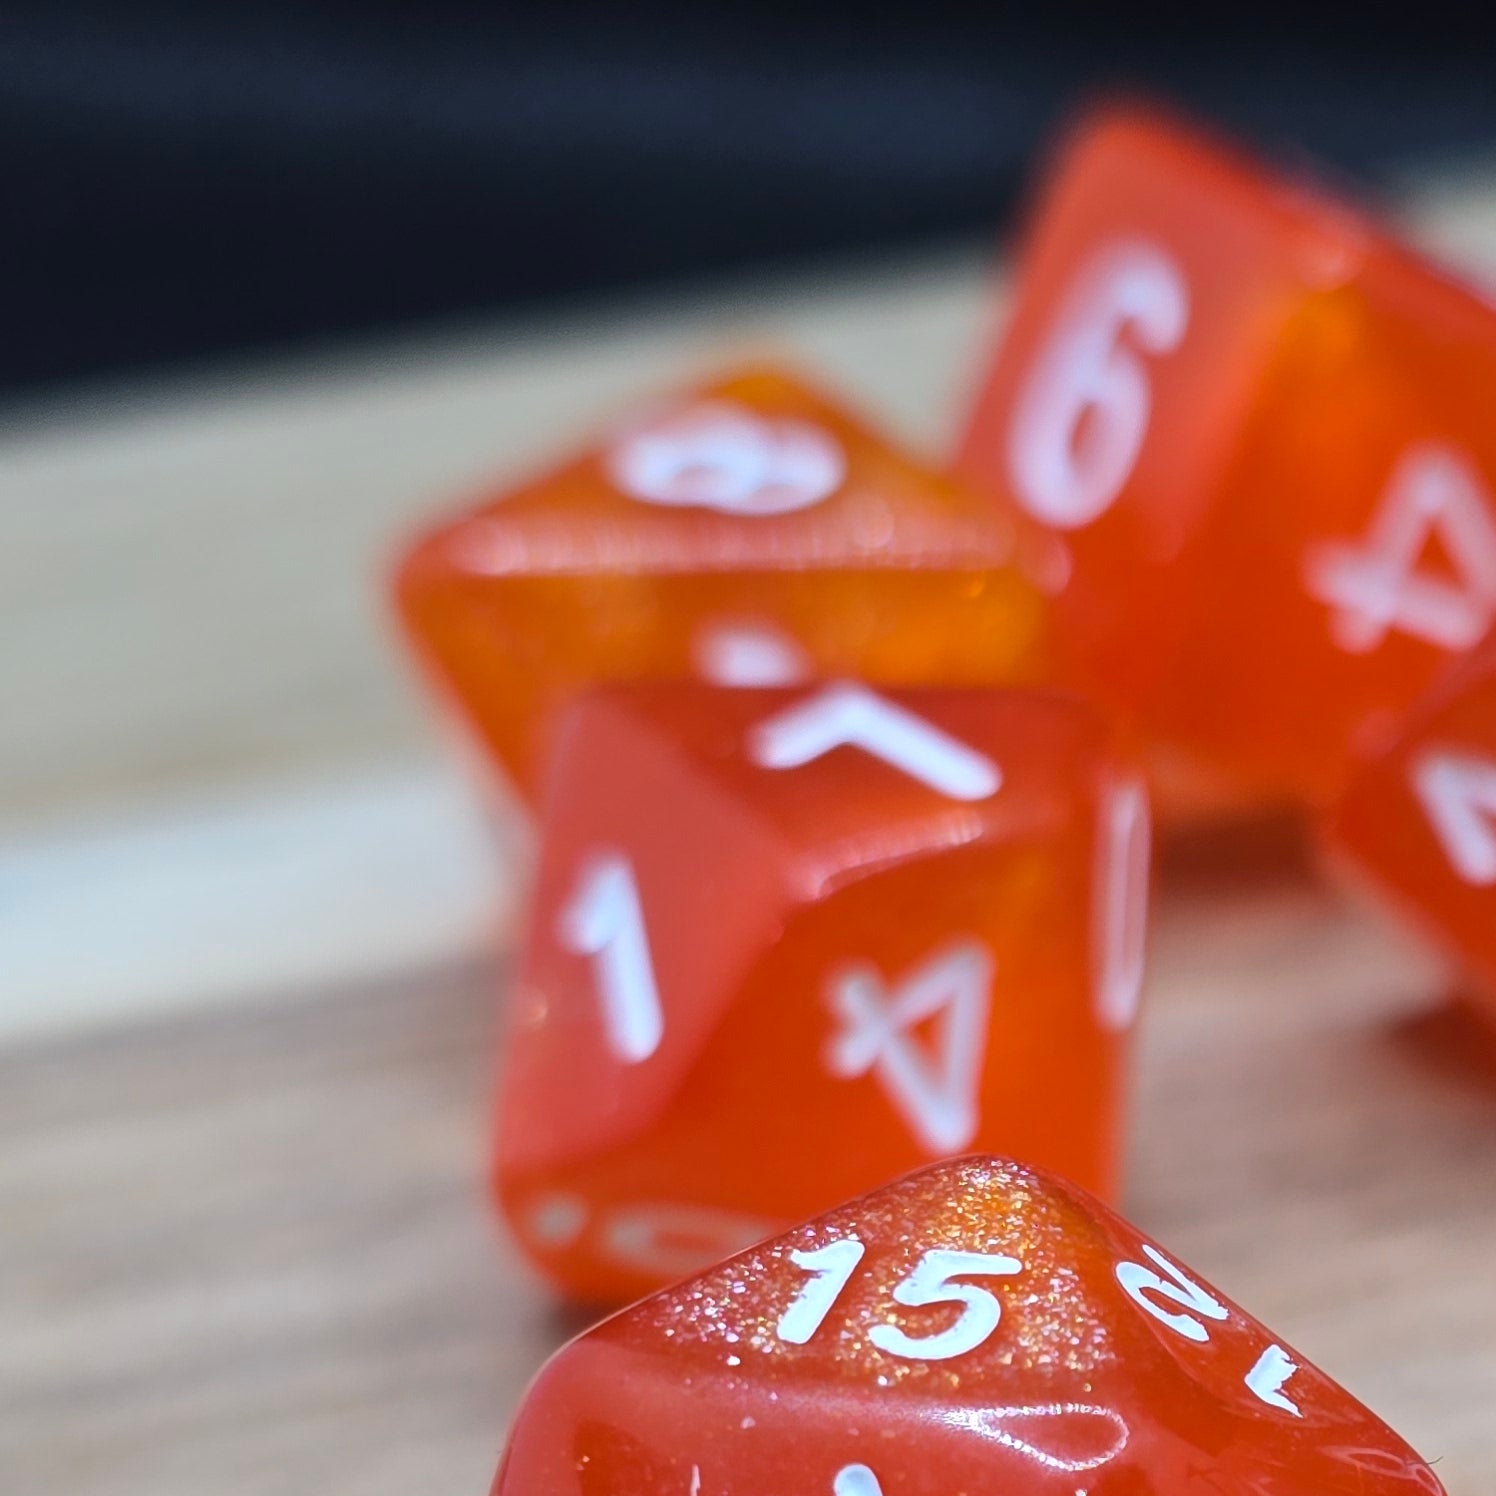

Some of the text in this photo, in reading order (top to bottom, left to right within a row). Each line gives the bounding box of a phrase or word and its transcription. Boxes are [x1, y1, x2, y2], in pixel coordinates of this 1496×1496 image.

[560, 848, 662, 1062] 1
[830, 938, 990, 1155] 4
[775, 1238, 1023, 1360] 15
